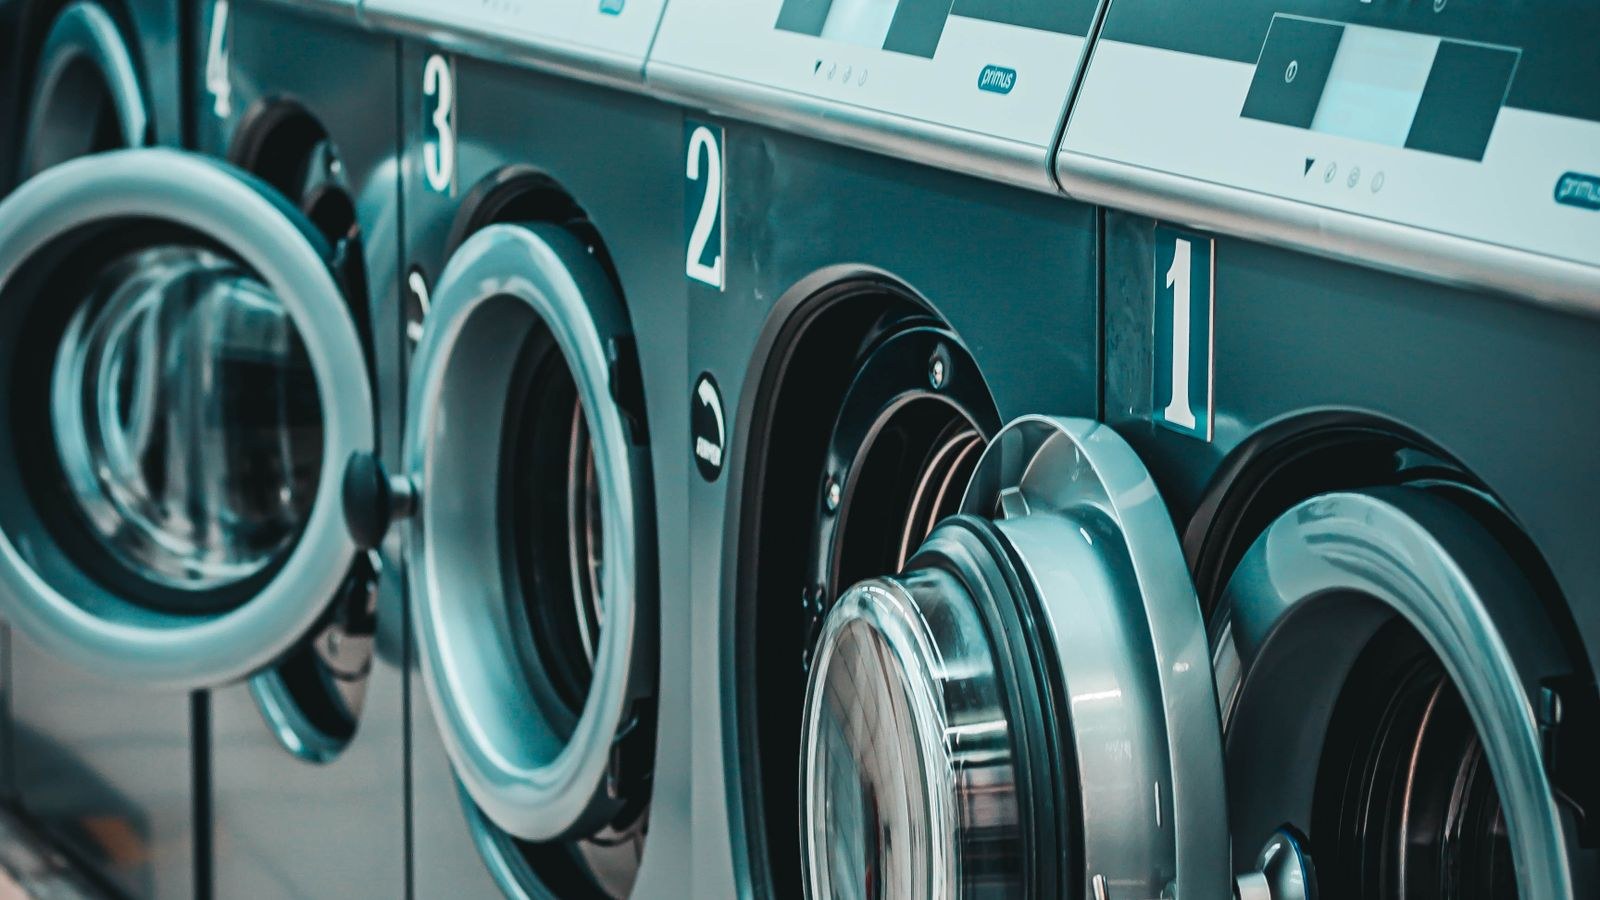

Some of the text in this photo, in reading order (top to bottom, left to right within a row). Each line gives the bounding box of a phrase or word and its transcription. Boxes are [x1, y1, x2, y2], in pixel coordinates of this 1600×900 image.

[206, 0, 231, 118] 4
[423, 54, 453, 191] 3
[981, 67, 1013, 89] primus
[686, 126, 721, 287] 2
[1164, 238, 1196, 430] 1
